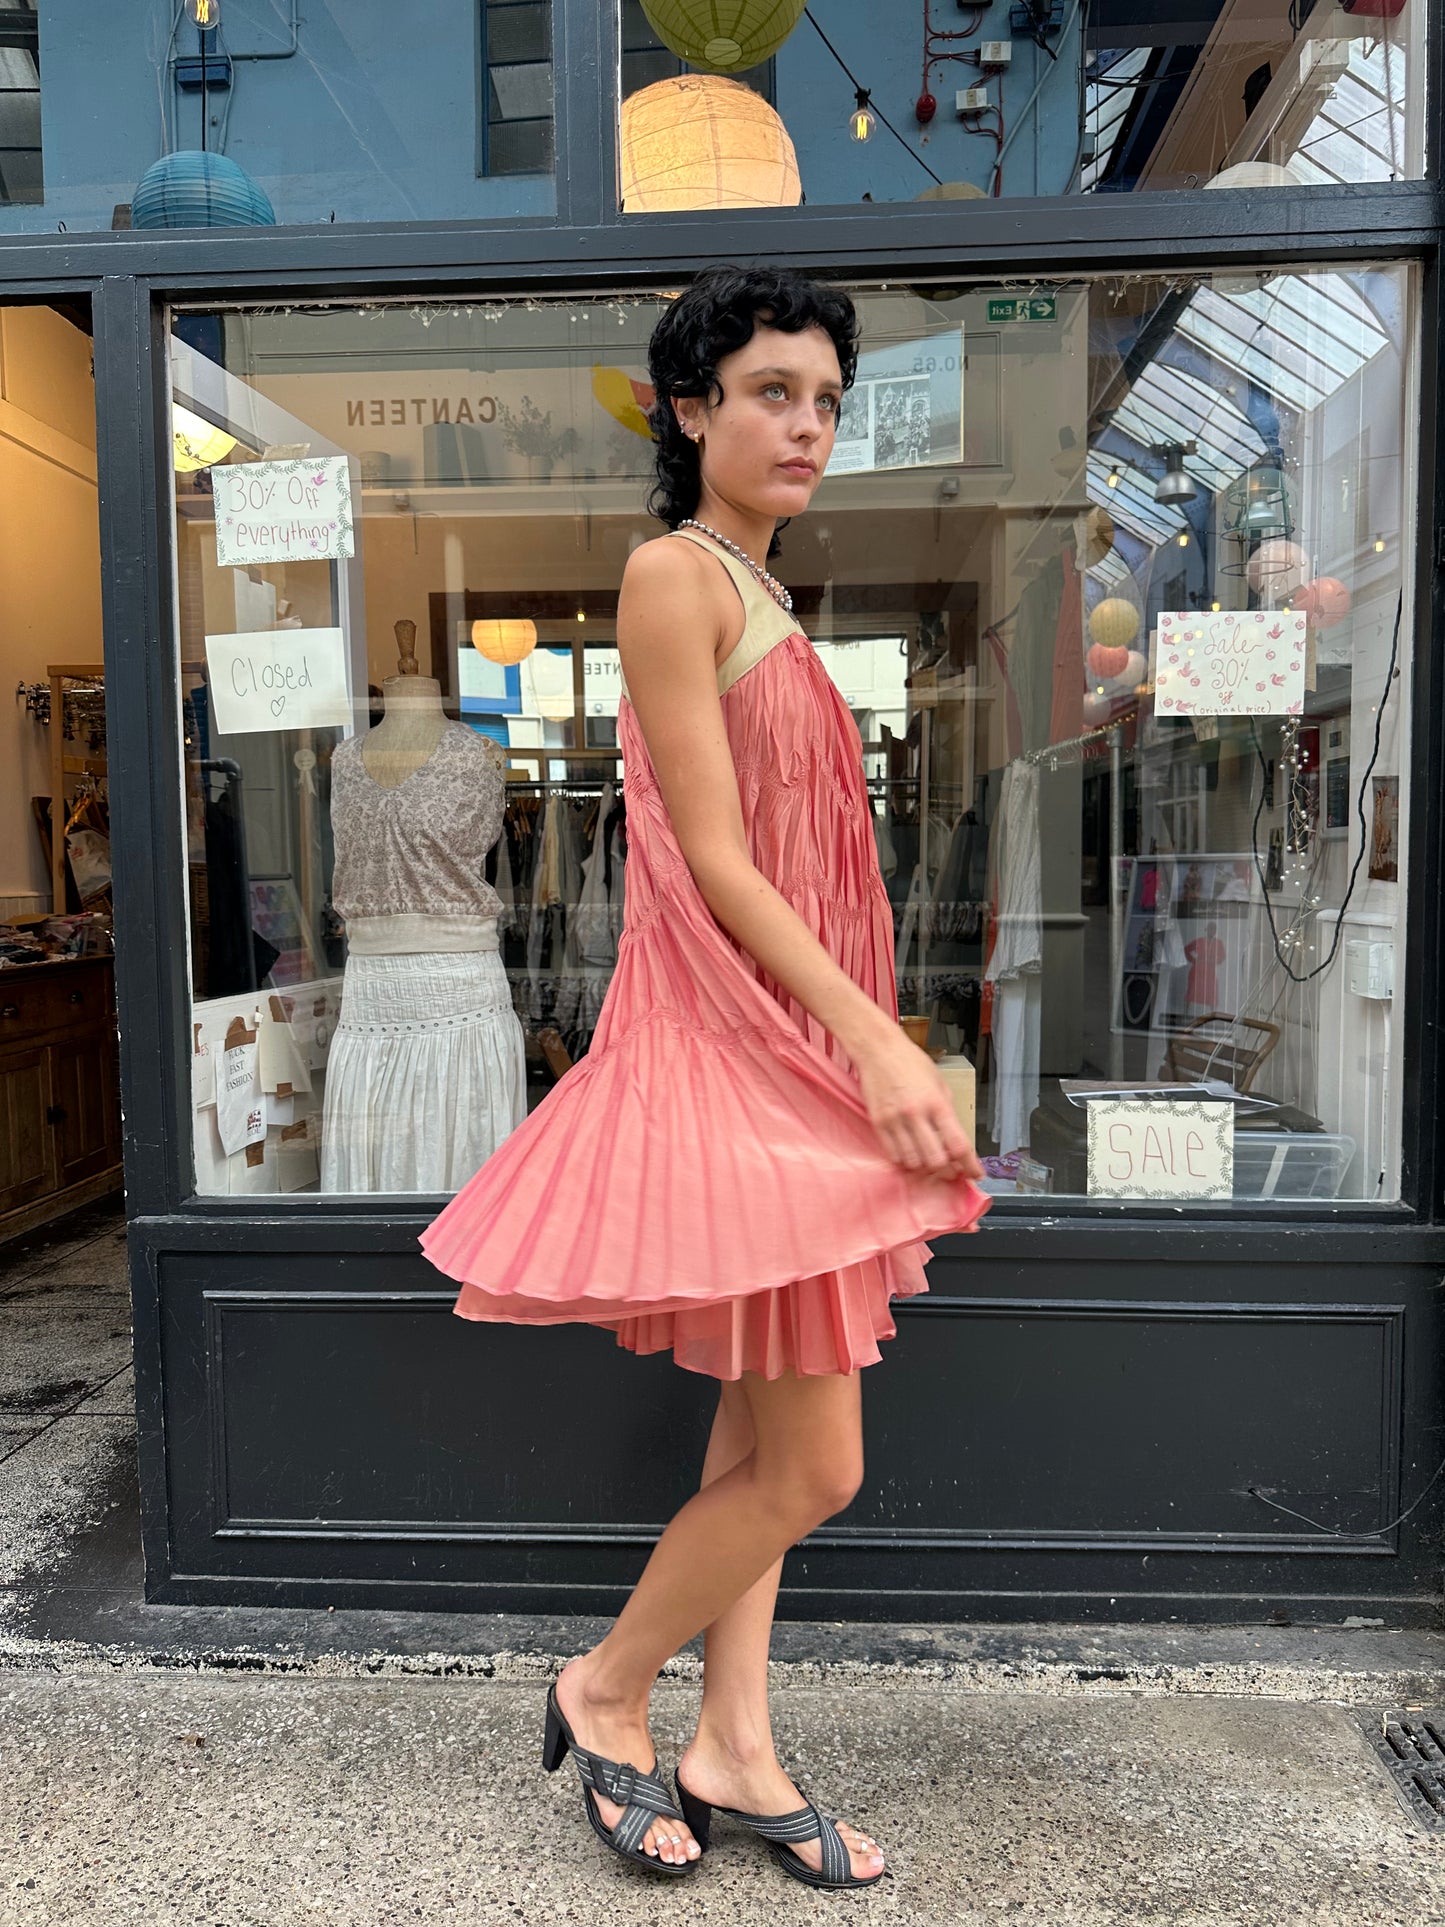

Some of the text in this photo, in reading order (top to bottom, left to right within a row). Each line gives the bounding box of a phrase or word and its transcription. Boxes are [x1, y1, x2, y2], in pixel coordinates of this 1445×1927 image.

[227, 476, 277, 512] 30%
[236, 520, 331, 552] everything
[1203, 622, 1264, 656] Sale
[231, 656, 313, 697] Closed
[1211, 658, 1250, 690] 30%
[1218, 690, 1234, 705] off
[226, 1071, 255, 1092] FASHION
[229, 1060, 245, 1075] FAST
